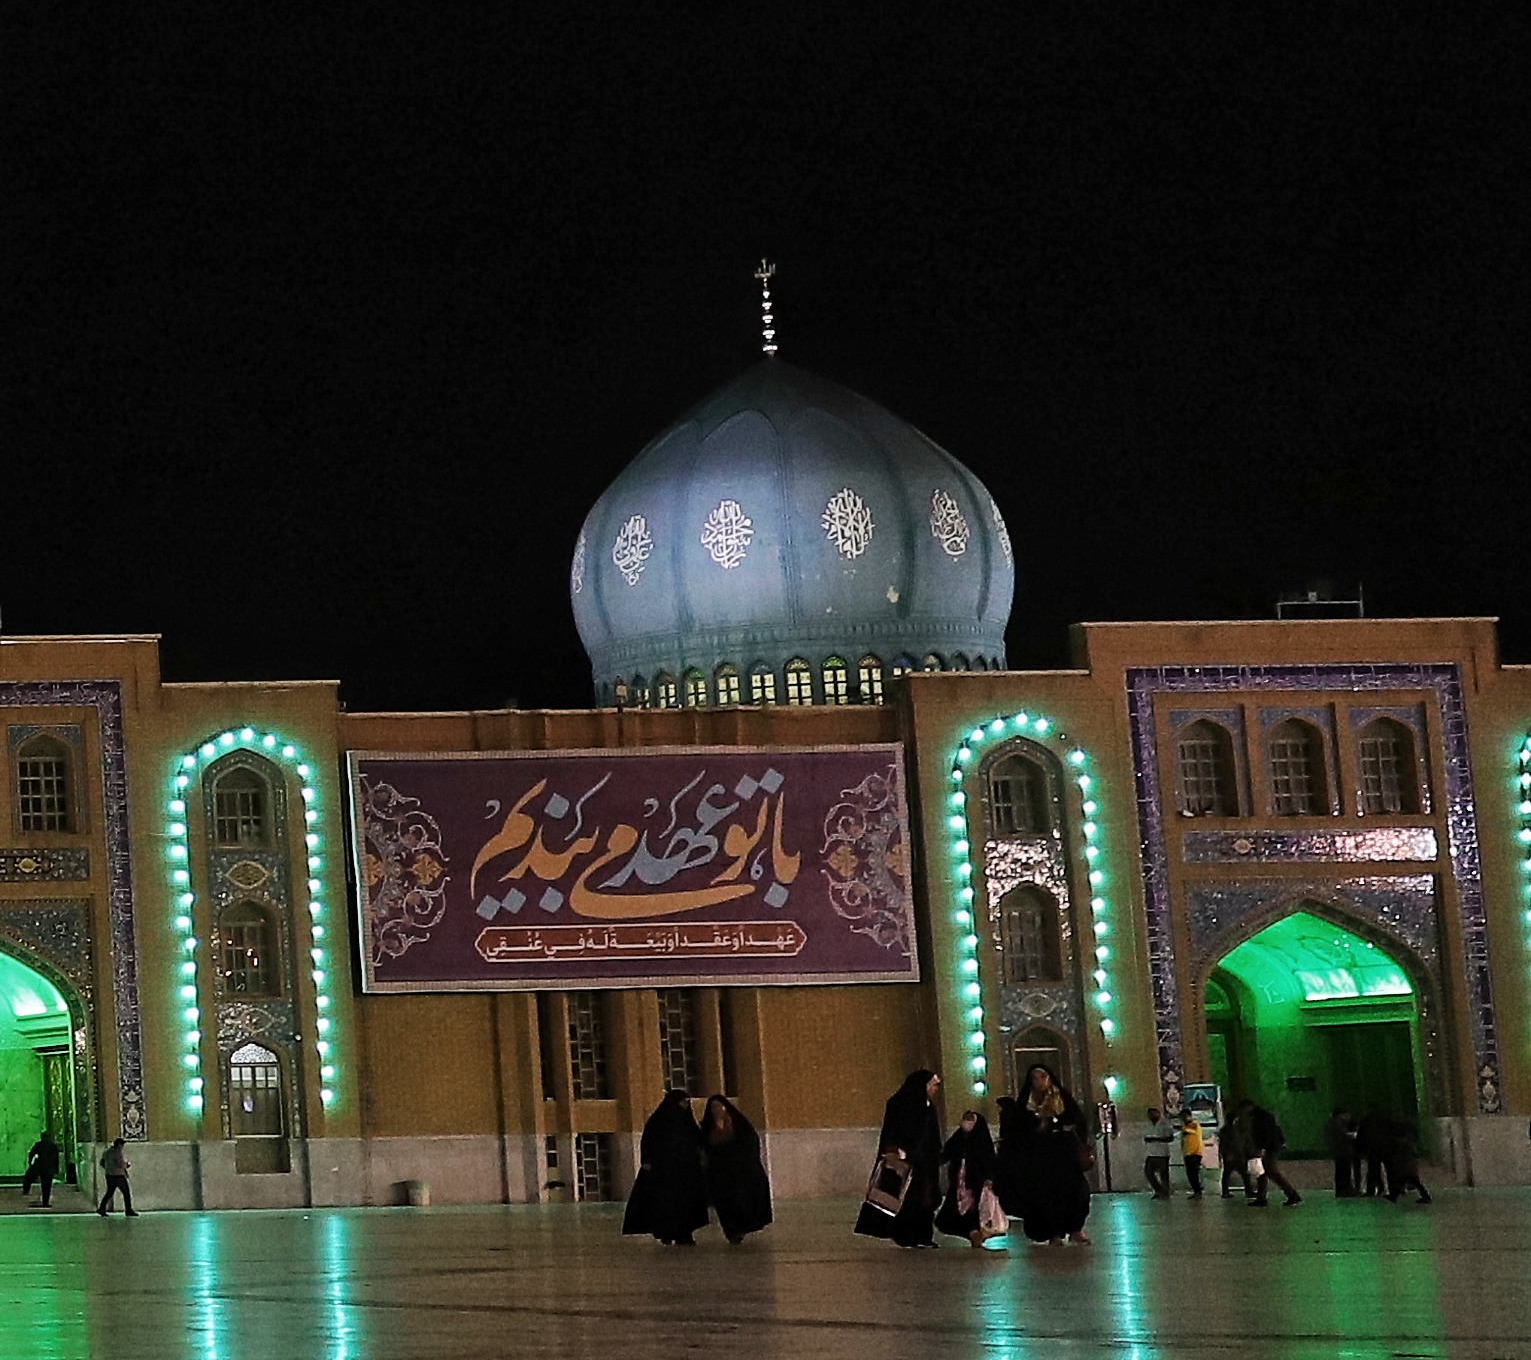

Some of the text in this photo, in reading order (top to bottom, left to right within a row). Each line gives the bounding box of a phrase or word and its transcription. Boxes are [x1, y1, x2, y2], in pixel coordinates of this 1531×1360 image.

[471, 768, 801, 921] با تو عهد می بندیم
